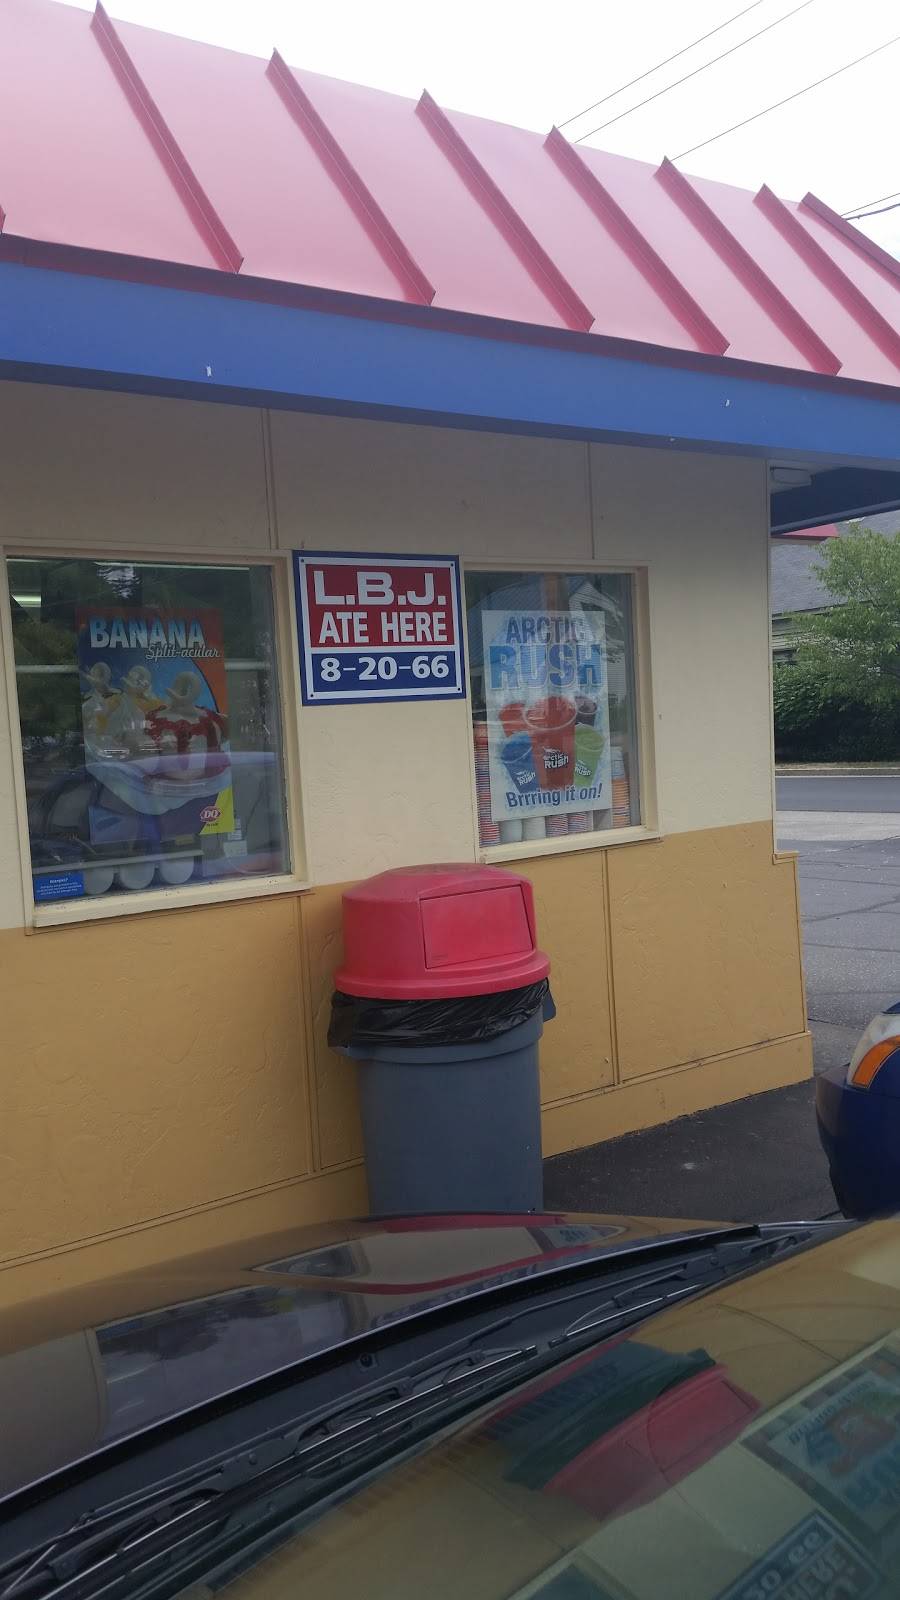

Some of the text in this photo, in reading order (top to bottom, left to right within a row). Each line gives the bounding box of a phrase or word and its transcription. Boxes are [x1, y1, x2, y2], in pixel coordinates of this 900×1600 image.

[313, 570, 446, 606] L.B.J.
[89, 615, 206, 649] BANANA
[319, 611, 448, 644] ATE HERE
[506, 615, 587, 644] ARCTIC
[146, 642, 220, 661] Split-acular
[489, 644, 603, 690] RUSH
[320, 655, 450, 682] 8-20-66
[506, 783, 603, 808] Brrring it on!
